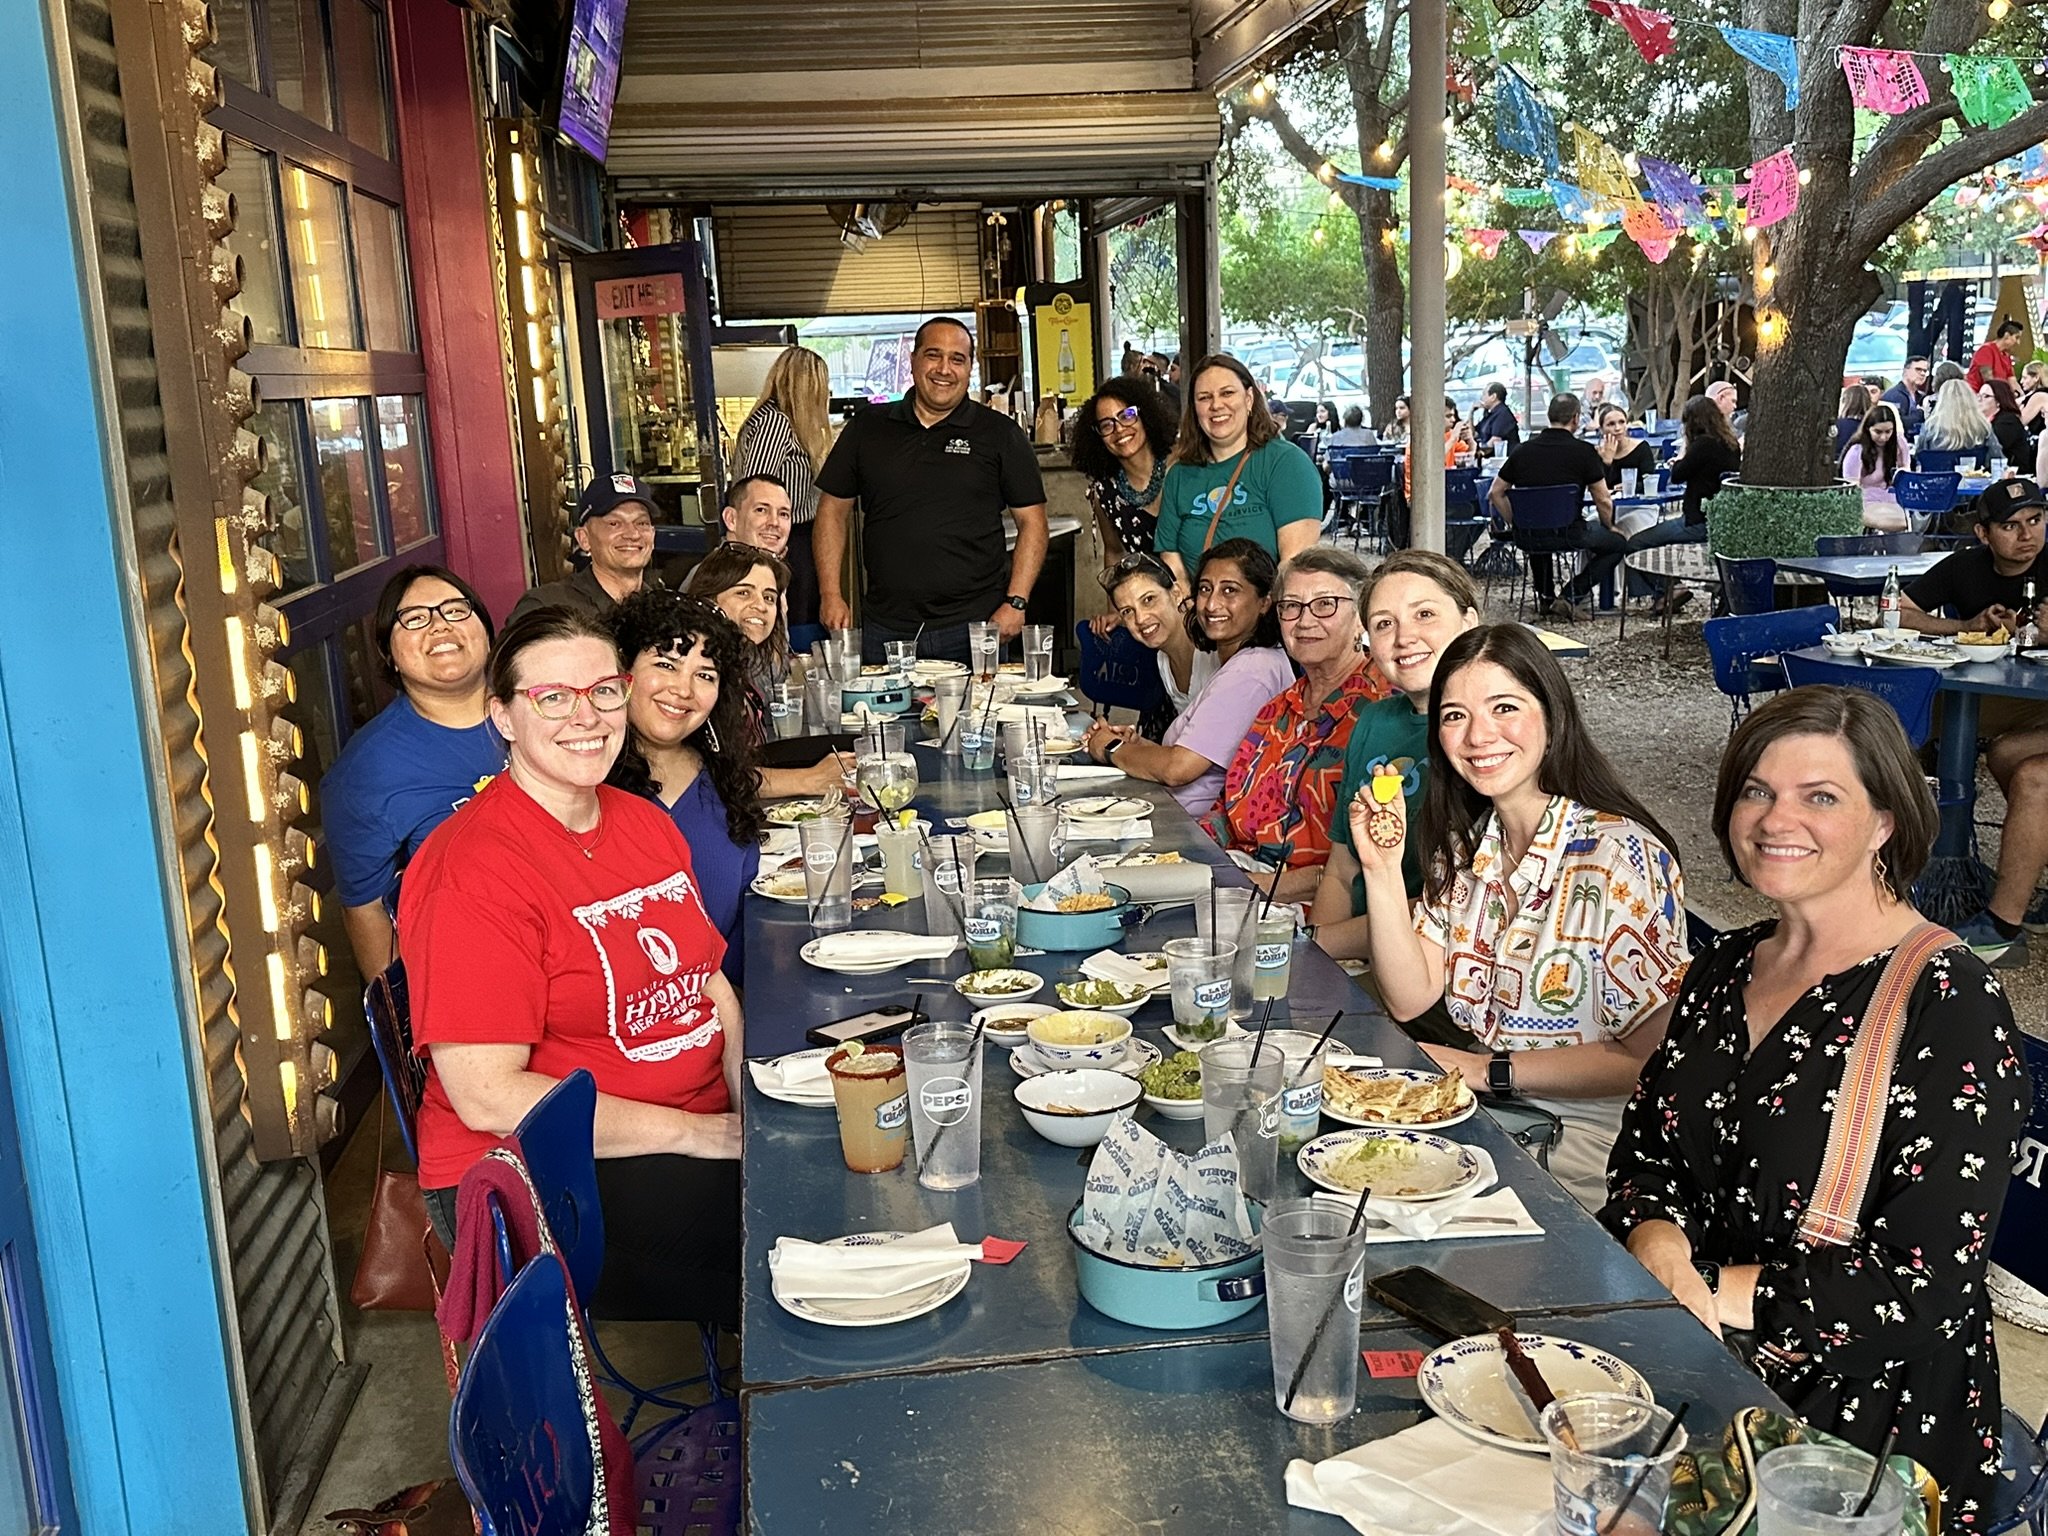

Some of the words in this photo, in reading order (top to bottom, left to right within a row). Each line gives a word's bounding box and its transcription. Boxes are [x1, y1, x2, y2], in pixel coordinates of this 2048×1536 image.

[612, 283, 634, 310] EXIT
[1208, 986, 1220, 994] LA
[922, 1092, 969, 1107] PEPSI
[1288, 1094, 1320, 1110] GLOR
[1298, 1091, 1311, 1100] LA
[882, 1109, 907, 1124] GLO
[1127, 1118, 1140, 1142] GLO
[1112, 1139, 1122, 1152] LA
[1102, 1135, 1132, 1178] GLORIA
[1091, 1175, 1101, 1183] LA
[1133, 1176, 1146, 1186] LA
[1222, 1177, 1234, 1187] LA
[1086, 1180, 1121, 1195] GLORIA
[1128, 1177, 1159, 1197] GLOR
[1164, 1211, 1174, 1226] LA
[1123, 1228, 1131, 1242] LA
[1126, 1208, 1148, 1253] GLORIA
[1154, 1207, 1181, 1249] GLORIA
[1186, 1237, 1208, 1264] GLOR
[1198, 1240, 1208, 1252] LA
[1214, 1232, 1252, 1254] GLORIA
